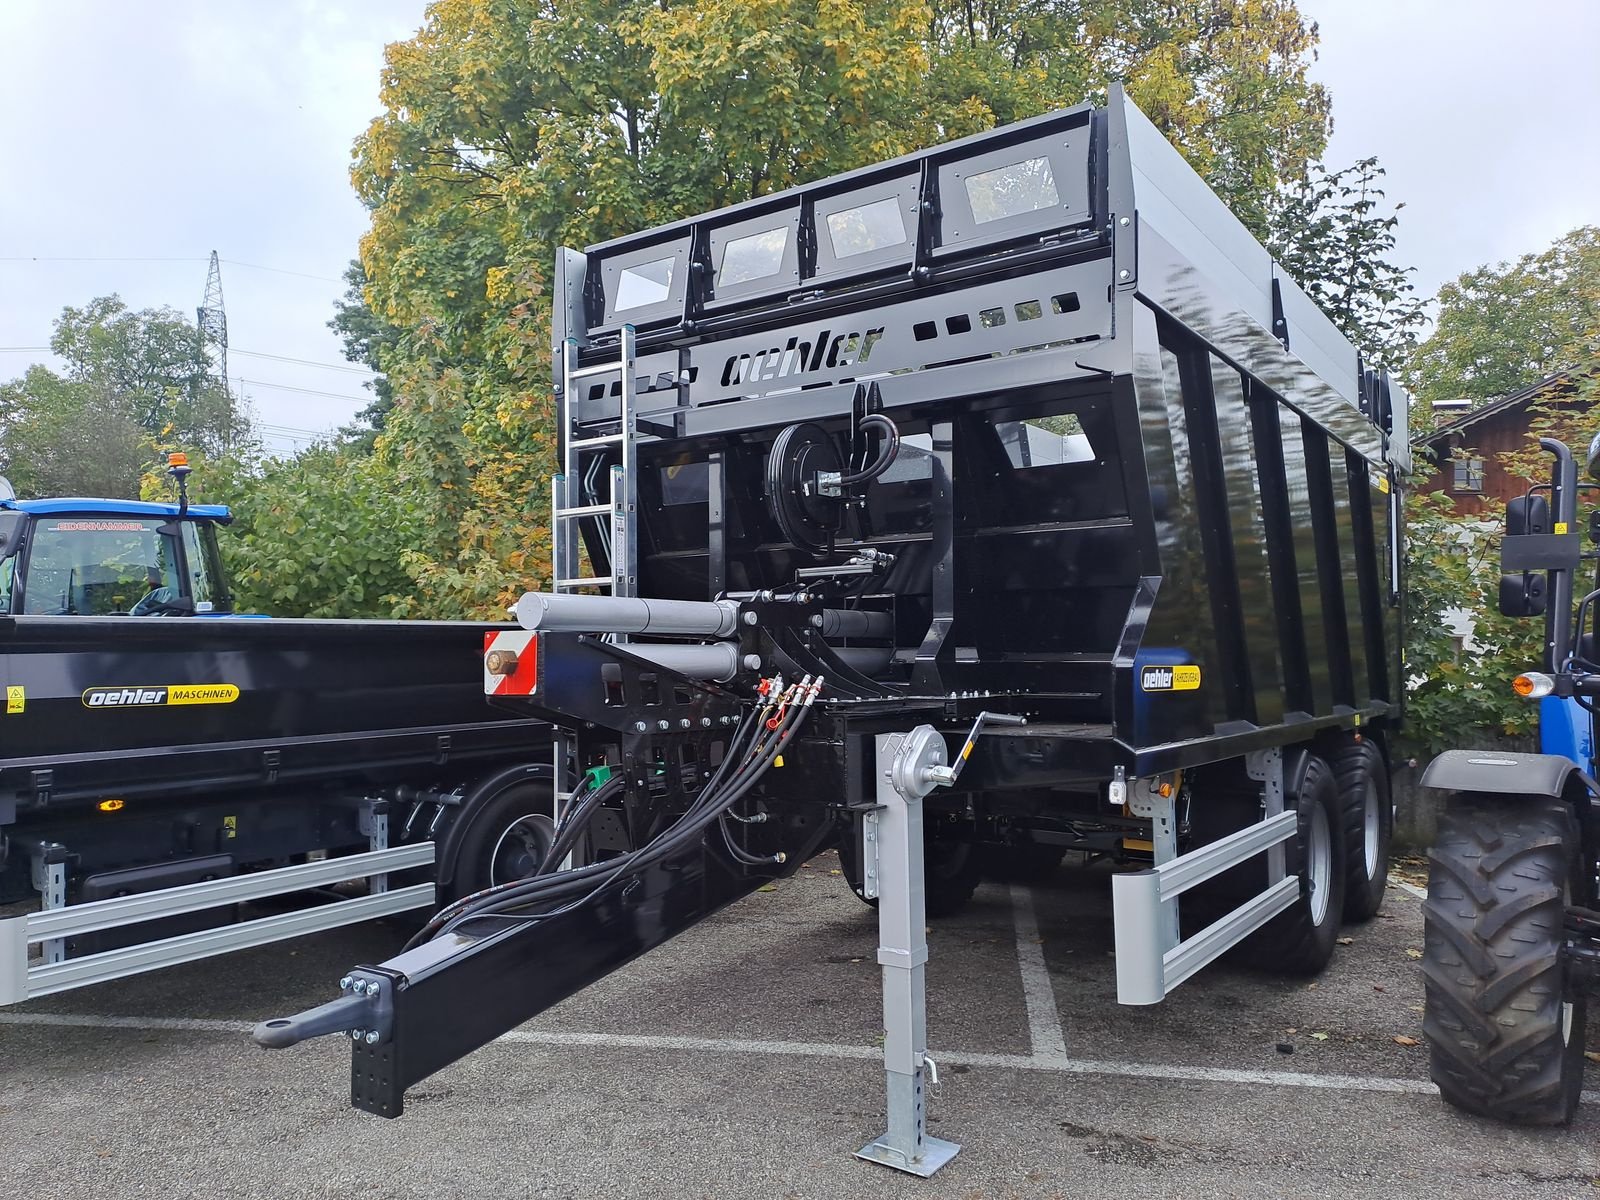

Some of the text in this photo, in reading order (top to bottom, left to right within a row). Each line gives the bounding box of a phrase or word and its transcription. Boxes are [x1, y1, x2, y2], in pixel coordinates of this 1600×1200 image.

[720, 326, 886, 387] oehler
[1143, 669, 1173, 688] oehler
[88, 688, 233, 706] oehler MASCHINEN
